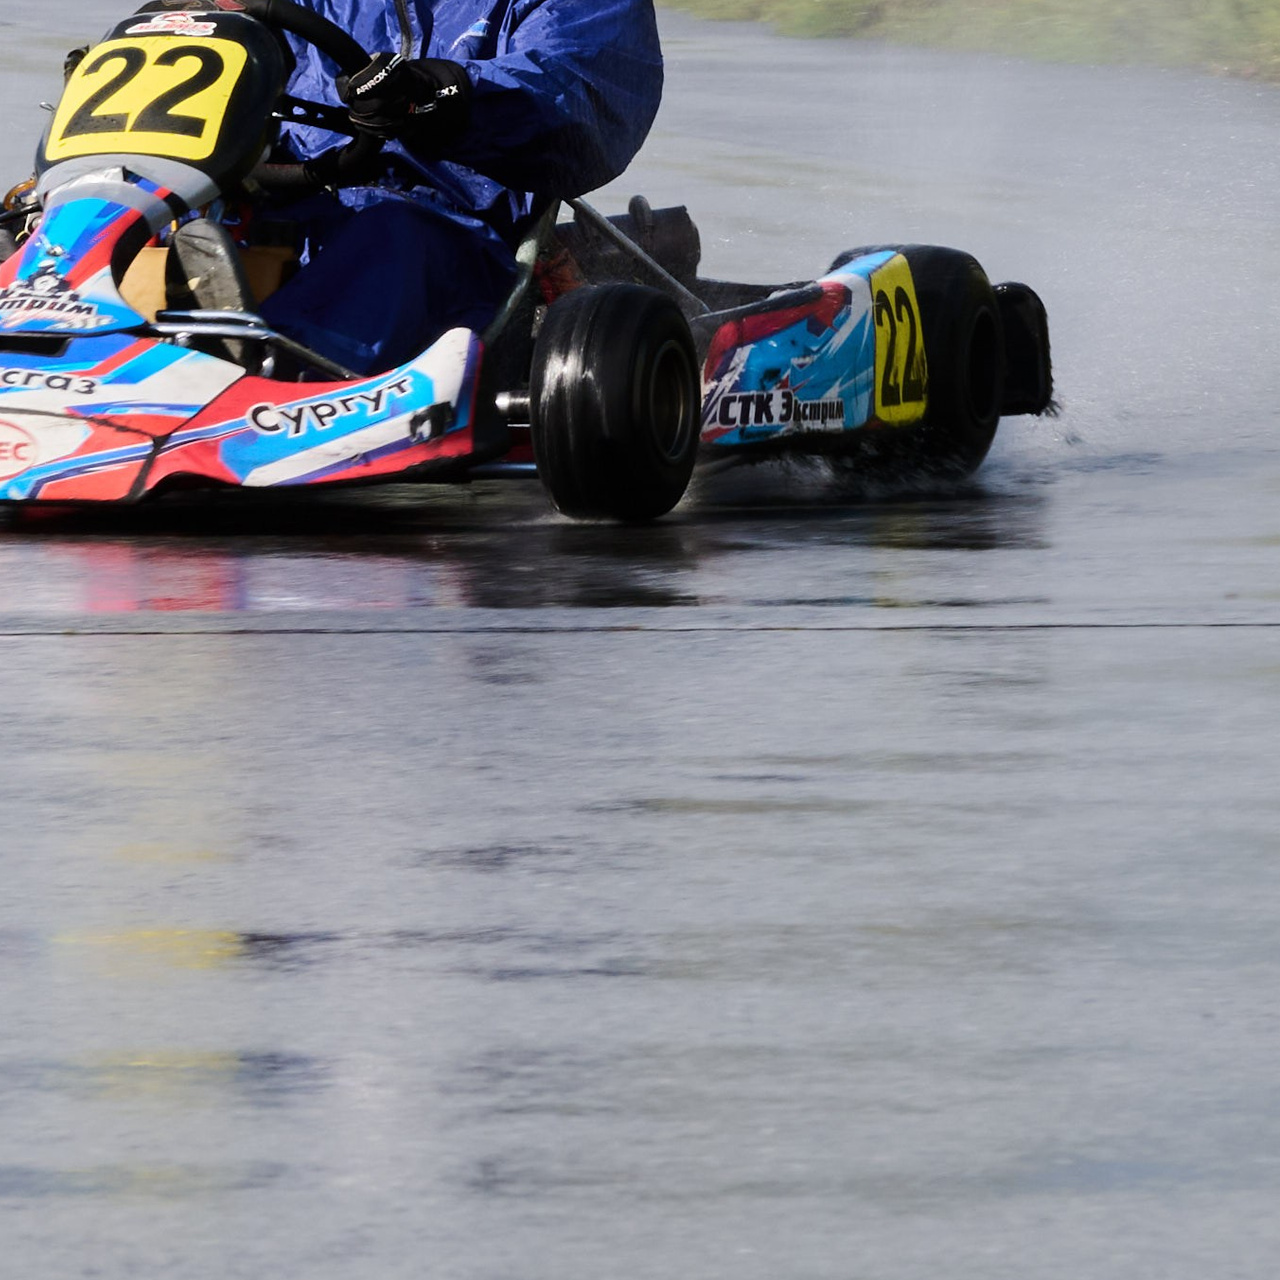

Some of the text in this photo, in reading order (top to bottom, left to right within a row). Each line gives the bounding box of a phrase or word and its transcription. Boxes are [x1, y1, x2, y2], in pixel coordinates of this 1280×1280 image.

[59, 45, 224, 141] 22
[876, 286, 924, 407] 22
[251, 378, 408, 434] Сургут
[719, 391, 844, 426] СТК Экстрим
